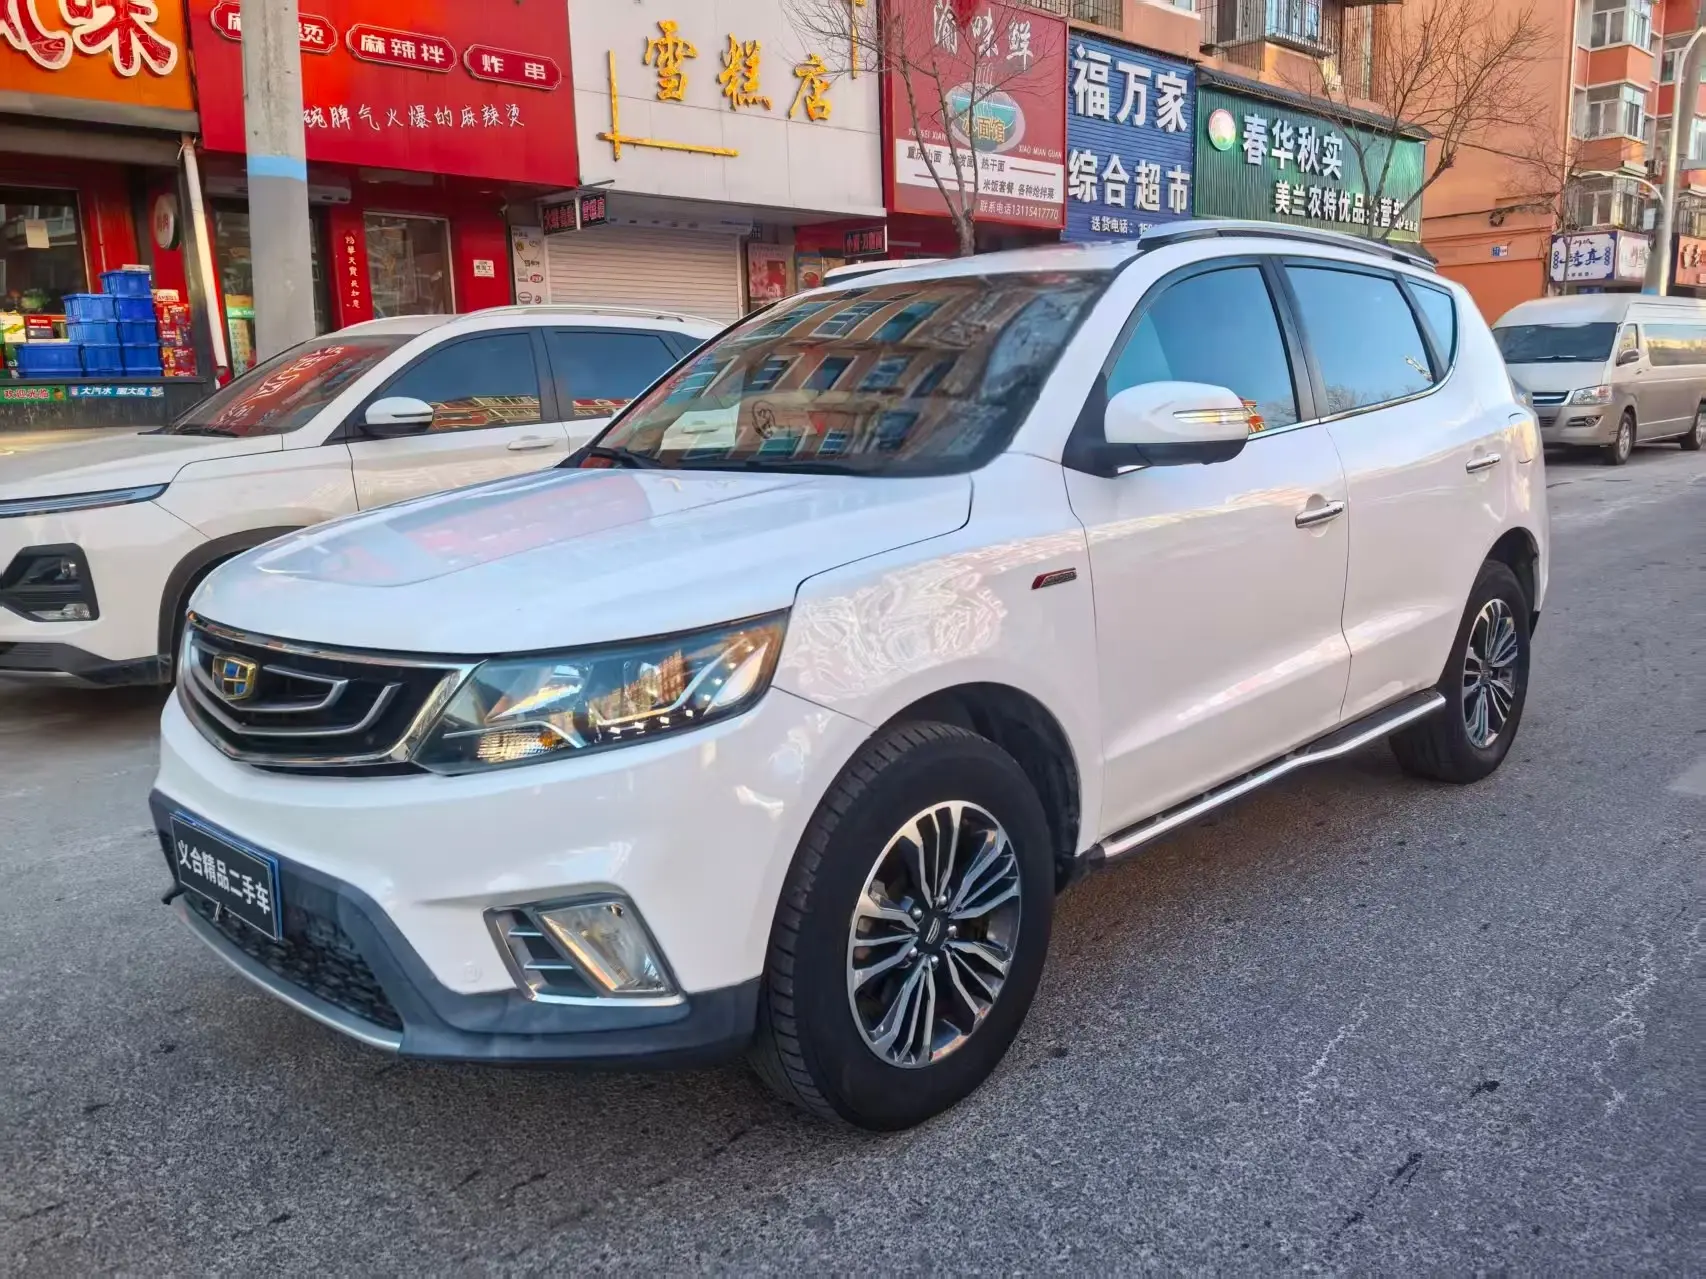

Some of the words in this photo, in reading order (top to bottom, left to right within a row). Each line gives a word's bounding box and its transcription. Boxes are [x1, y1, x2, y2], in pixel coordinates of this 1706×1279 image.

[360, 34, 445, 64] 麻辣拌
[481, 53, 546, 81] 炸串
[642, 19, 832, 122] 雪糕店
[1073, 43, 1188, 133] 福万家
[981, 157, 1006, 173] 热干面
[1243, 113, 1343, 181] 春华秋实
[983, 178, 1015, 196] 米饭套餐
[1068, 148, 1191, 215] 综合超市
[80, 386, 113, 396] 大汽水
[177, 839, 271, 915] 义合精品二手车
